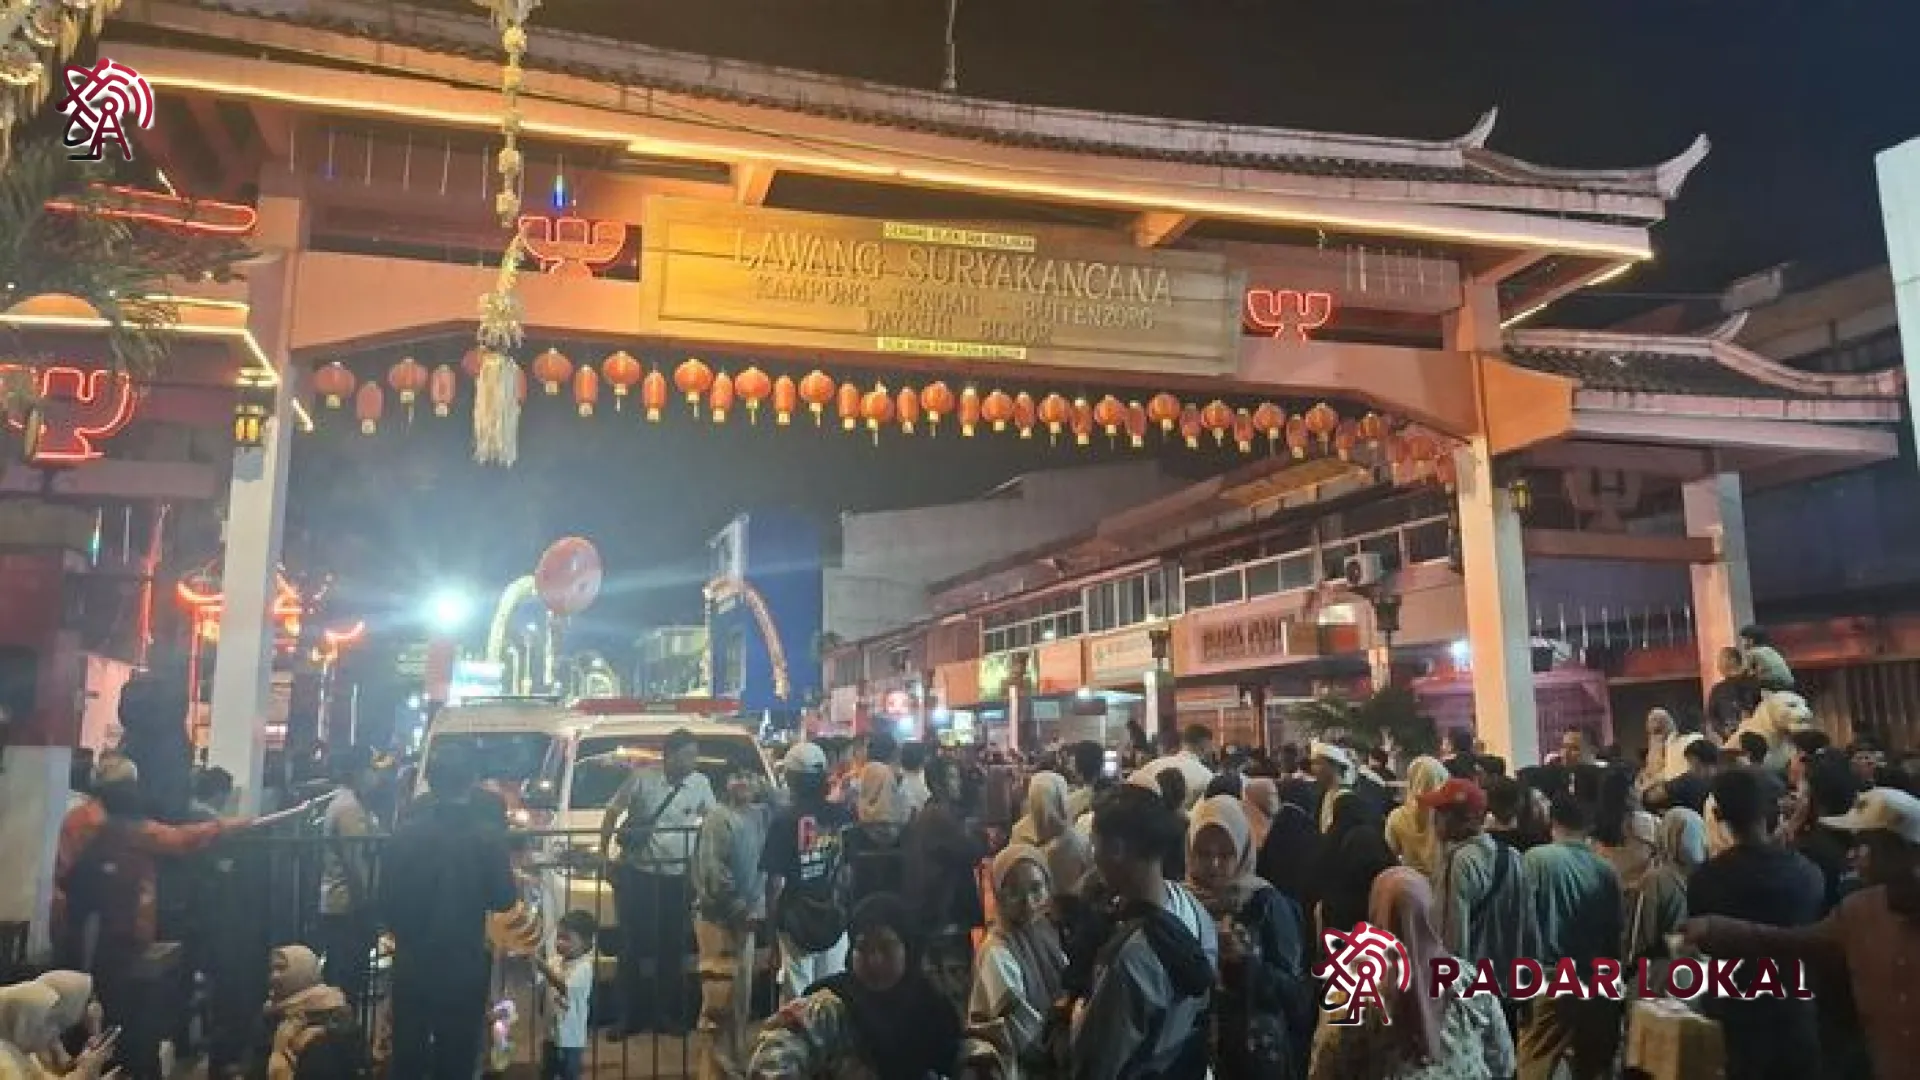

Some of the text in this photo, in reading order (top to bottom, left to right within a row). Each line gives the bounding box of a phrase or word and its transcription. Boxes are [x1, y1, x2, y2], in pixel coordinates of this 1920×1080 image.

[733, 231, 883, 279] LAWANG
[905, 246, 1172, 305] SURYAKANCANA
[1022, 299, 1153, 331] BUITENZORG
